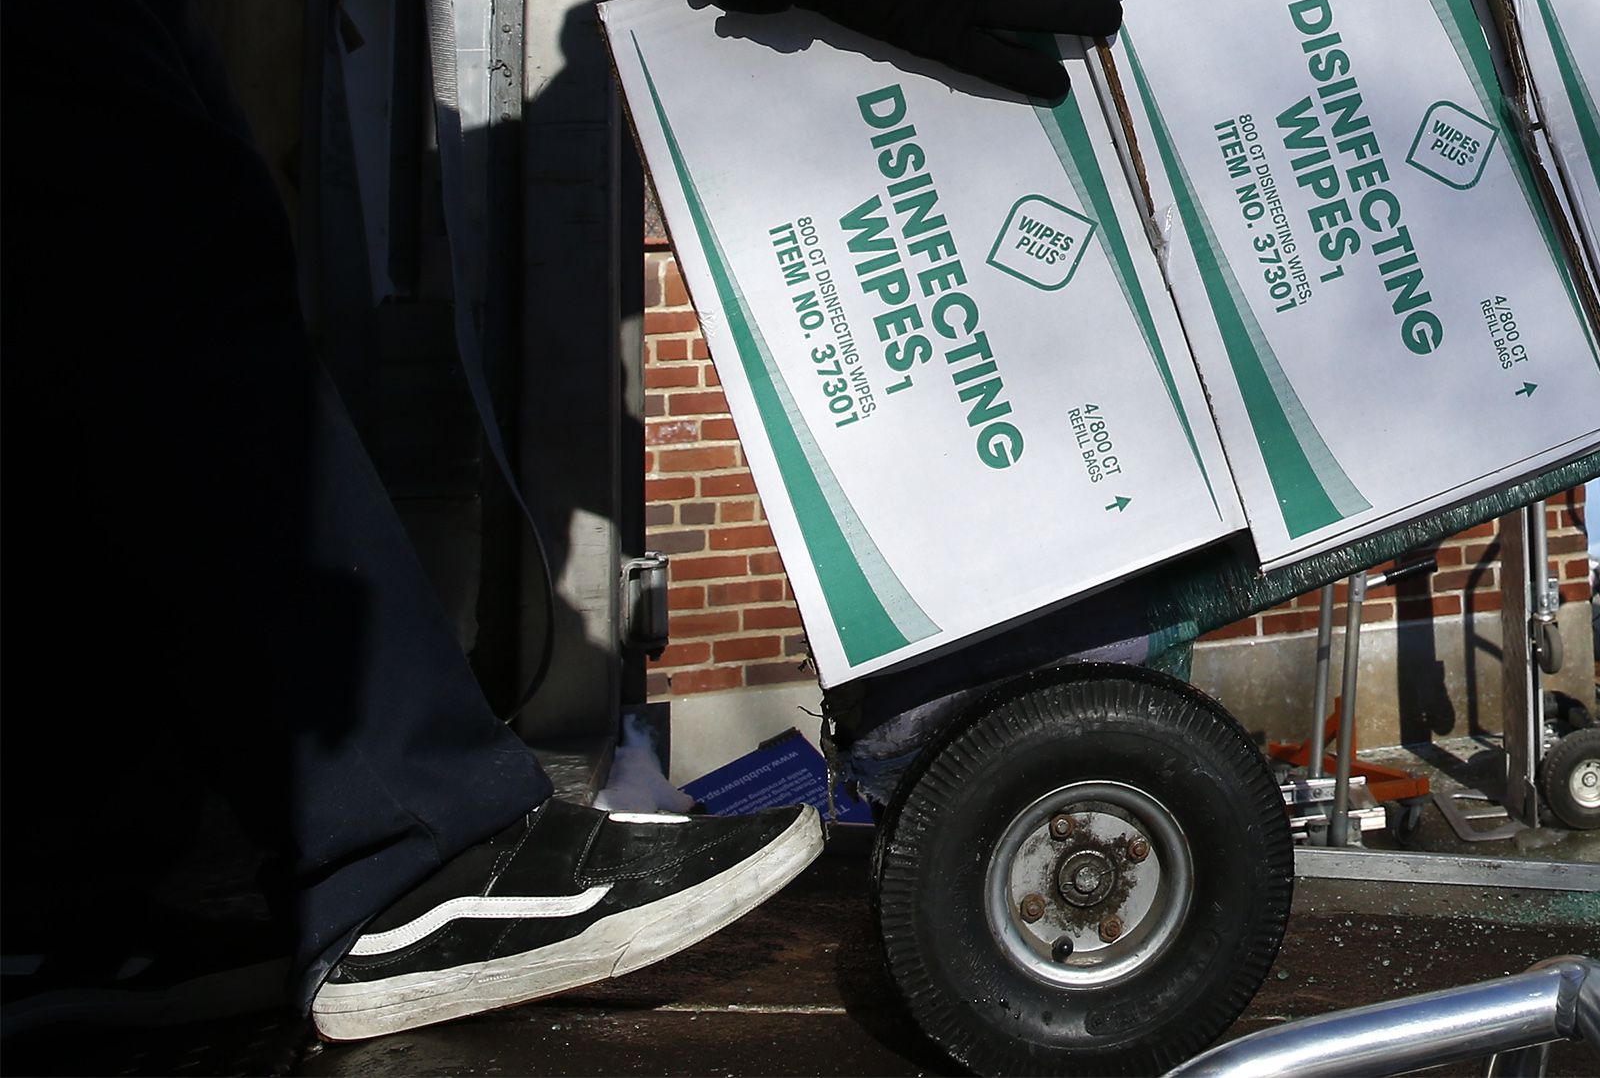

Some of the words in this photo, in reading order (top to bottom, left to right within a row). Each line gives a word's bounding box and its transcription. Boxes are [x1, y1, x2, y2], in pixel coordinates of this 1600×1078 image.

[1239, 114, 1258, 141] 800
[1249, 145, 1265, 160] CT
[1433, 120, 1480, 154] WIPES
[798, 217, 818, 246] 800
[1019, 216, 1073, 251] WIPES
[1214, 119, 1251, 178] ITEM
[1235, 183, 1264, 228] NO.
[1253, 234, 1297, 313] 37301
[1256, 164, 1296, 254] DISINFECTING
[809, 249, 826, 266] CT
[856, 83, 1023, 469] DISINFECTING
[769, 223, 810, 286] ITEM
[792, 290, 824, 339] NO.
[811, 344, 859, 428] 37301
[815, 270, 859, 365] DISINFECTING
[1480, 299, 1500, 337] REFILL
[1494, 338, 1512, 369] BAGS
[1495, 296, 1519, 341] 4/800
[1511, 345, 1528, 362] CT
[1068, 408, 1090, 449] REFILL
[1082, 449, 1103, 483] BAGS
[1084, 404, 1112, 452] 4/800
[1102, 456, 1121, 475] CT
